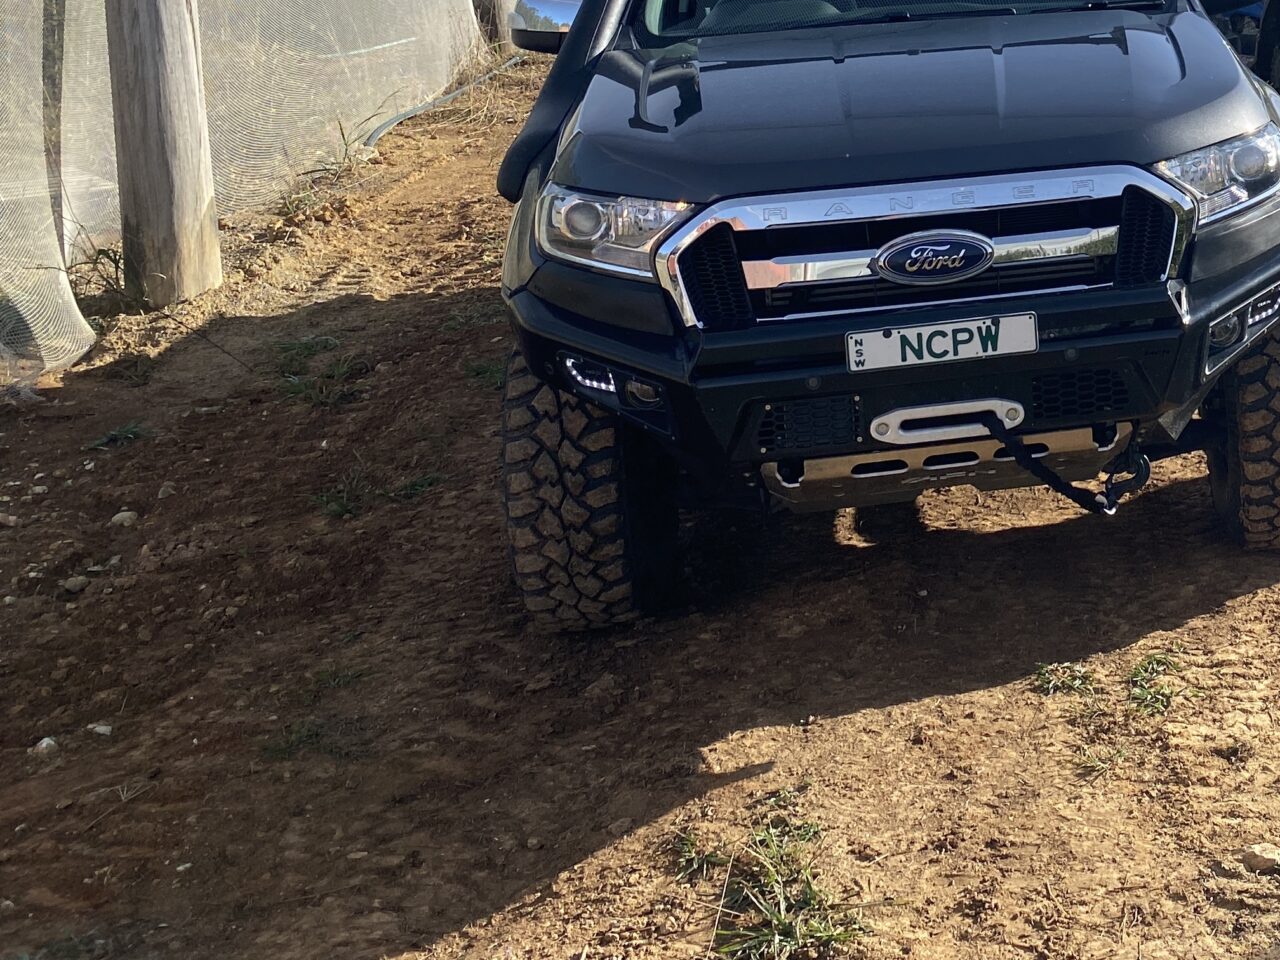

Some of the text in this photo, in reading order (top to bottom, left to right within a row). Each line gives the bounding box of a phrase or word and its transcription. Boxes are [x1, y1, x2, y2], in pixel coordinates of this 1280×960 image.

[763, 179, 1096, 221] RANGER
[904, 244, 966, 273] Ford
[854, 338, 866, 368] NSW
[899, 320, 1001, 363] NCPW
